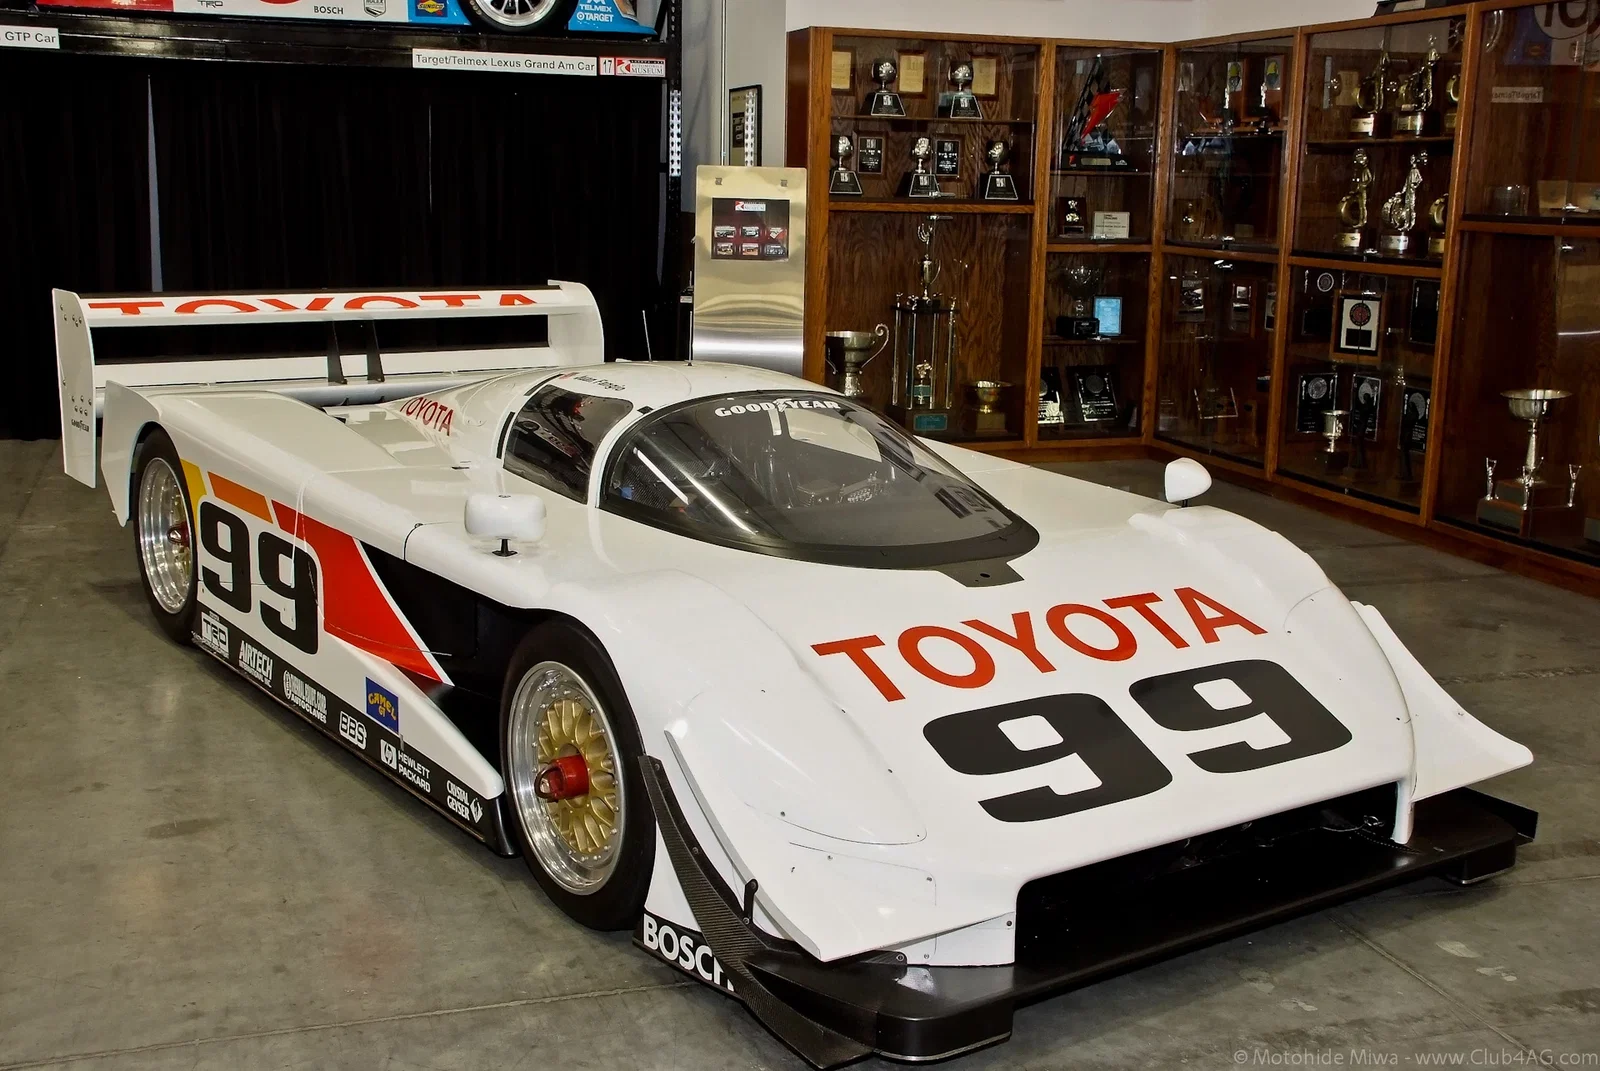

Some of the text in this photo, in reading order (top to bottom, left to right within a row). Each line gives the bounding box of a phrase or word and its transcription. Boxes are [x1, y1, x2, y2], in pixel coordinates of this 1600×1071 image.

[314, 5, 344, 15] BOSCH
[580, 4, 612, 13] TELMEX
[585, 12, 614, 22] TARGET
[5, 31, 56, 43] GTP Car
[416, 54, 595, 71] Target/Telmex Lexus Grand Am Car
[88, 293, 537, 315] TOYOTA
[400, 396, 454, 437] TOYOTA
[715, 398, 840, 417] GOODYEAR
[200, 501, 319, 655] 99
[203, 618, 227, 646] TRD
[810, 587, 1269, 703] TOYOTA
[239, 640, 273, 680] AIRTECH
[368, 693, 397, 721] CAMEL
[378, 705, 386, 718] GT
[339, 711, 367, 750] BBS
[922, 659, 1353, 823] 99
[398, 750, 431, 780] HEWLETT
[399, 763, 431, 793] PACKARD
[447, 780, 470, 806] CRYSTAL
[447, 795, 470, 821] GEYSER
